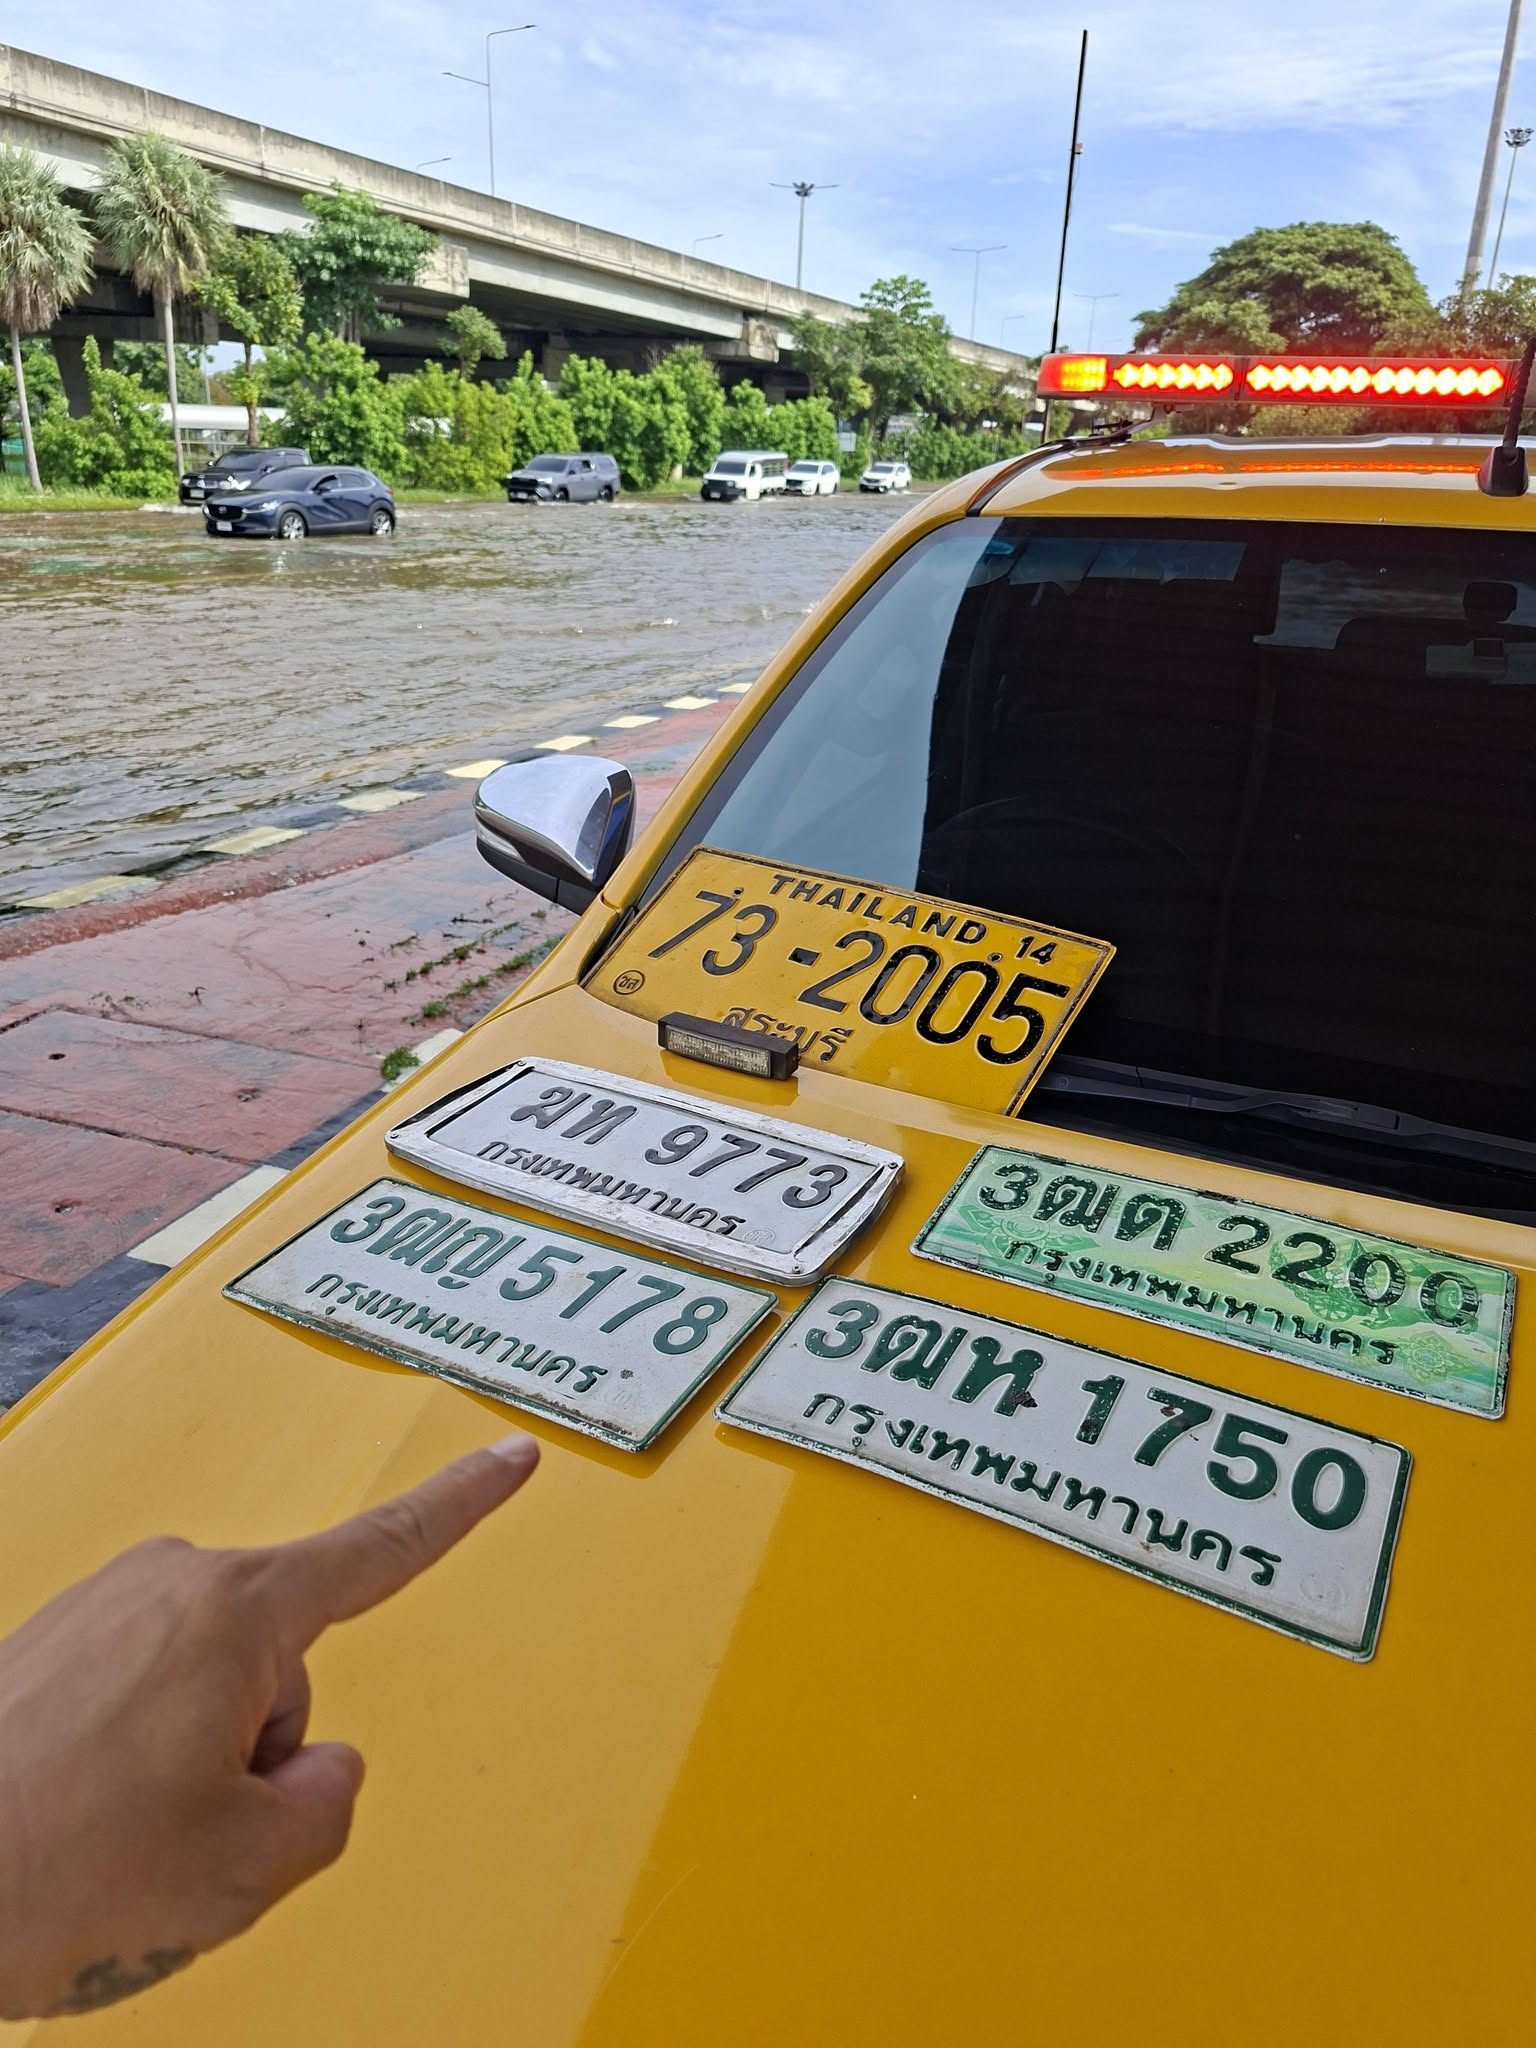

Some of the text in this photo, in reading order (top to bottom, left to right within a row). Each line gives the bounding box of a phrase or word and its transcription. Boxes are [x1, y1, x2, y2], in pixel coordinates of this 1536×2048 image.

[768, 874, 1058, 966] THAILAND 14
[721, 1007, 854, 1063] สระบรี
[476, 1139, 749, 1236] กรงเทพมหานคร
[644, 1124, 849, 1209] 9773
[498, 1243, 729, 1356] 5178
[1003, 1238, 1401, 1366] กรุงเทพมหานคร
[1204, 1214, 1481, 1329] 2200
[304, 1272, 609, 1393] กรุงเทพมหานคร
[801, 1390, 1283, 1588] กรุงเทพมหานคร
[1073, 1374, 1368, 1532] 1750
